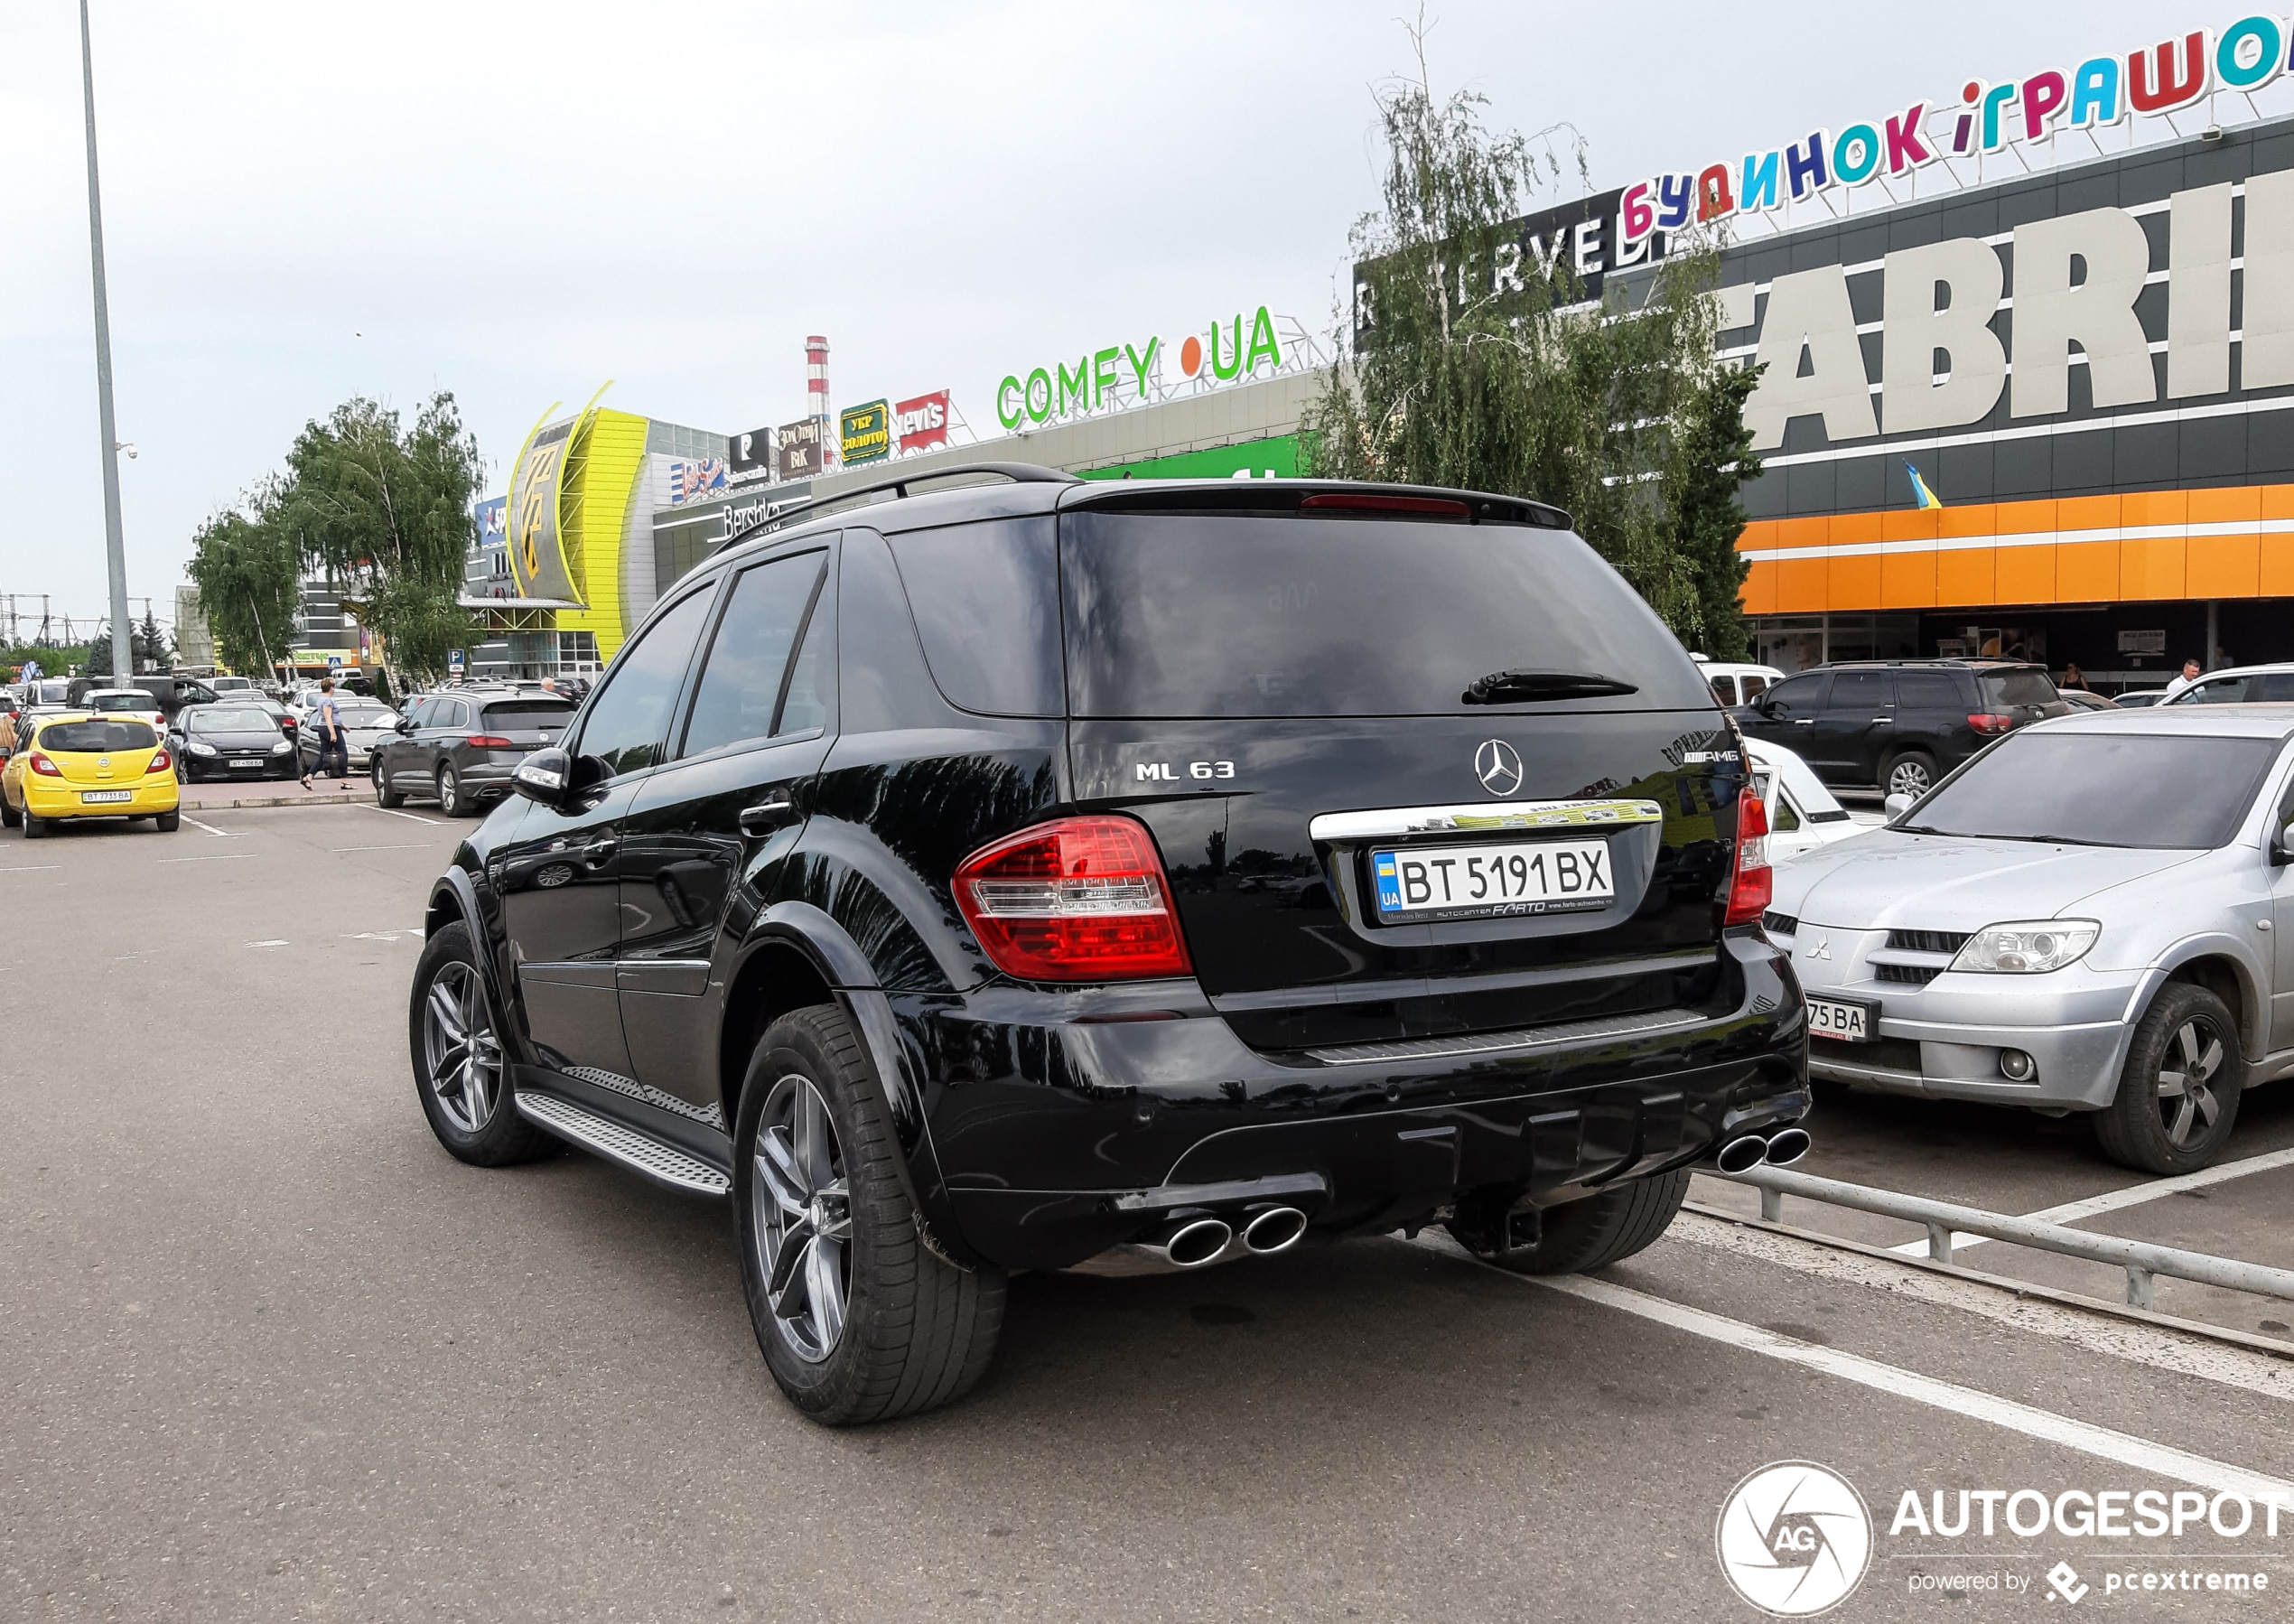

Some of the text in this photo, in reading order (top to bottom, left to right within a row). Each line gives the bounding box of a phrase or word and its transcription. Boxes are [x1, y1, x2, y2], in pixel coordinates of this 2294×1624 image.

[1621, 14, 2294, 246] БУДИНОК іГРАШО
[996, 304, 1286, 430] COMFY UA
[851, 415, 873, 432] УКР
[842, 431, 884, 452] ЗОЛОТО
[723, 497, 782, 538] Bershka
[452, 651, 461, 662] P
[1700, 750, 1739, 763] AMG
[1135, 761, 1236, 781] ML 63
[1402, 849, 1608, 904] BT 5191 BX
[1382, 892, 1400, 907] UA
[1436, 908, 1491, 918] AUTOCENTER
[1808, 1003, 1862, 1032] 75 BA
